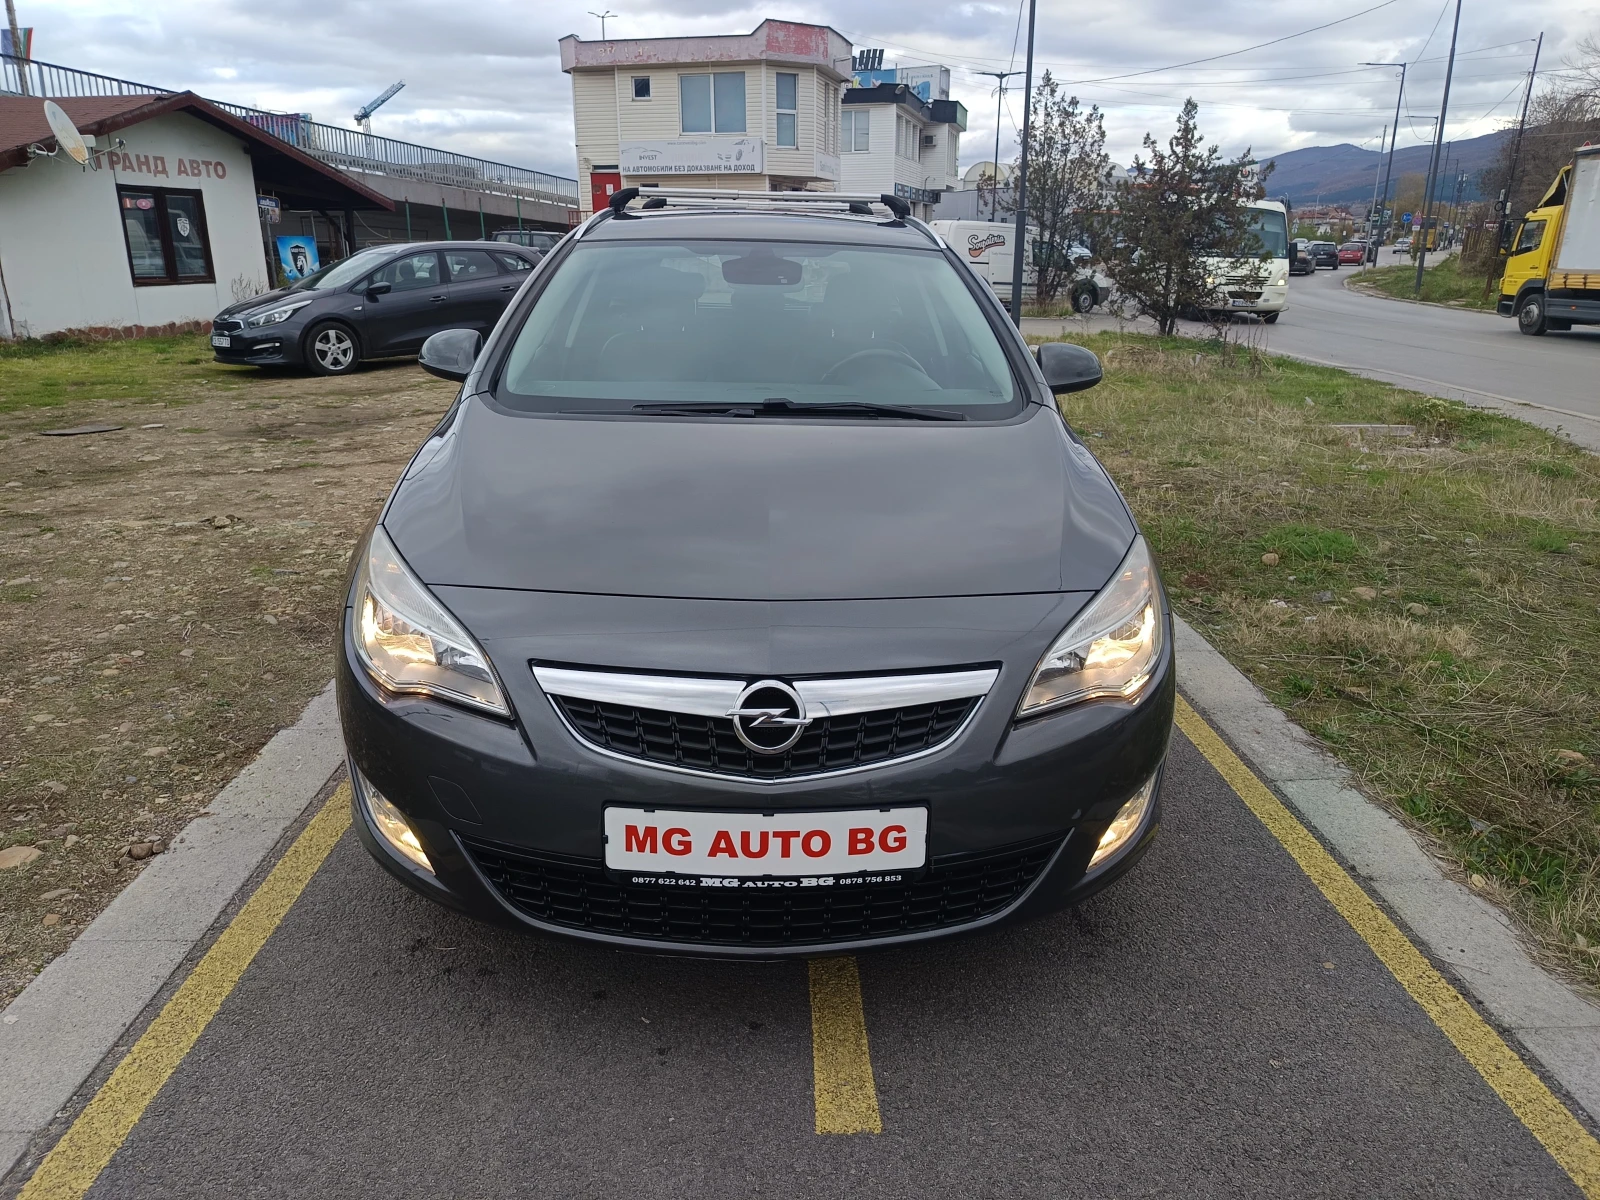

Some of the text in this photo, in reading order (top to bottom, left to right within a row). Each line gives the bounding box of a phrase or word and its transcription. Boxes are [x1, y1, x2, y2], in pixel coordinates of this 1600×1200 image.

[94, 150, 227, 180] ГРАНД АВТО
[632, 165, 673, 173] АВТОМОБИЛИ
[687, 164, 723, 173] ДОКАЗВАНЕ
[724, 164, 732, 172] НА
[733, 164, 755, 173] ДОХОД
[968, 233, 1006, 252] Soupateria
[624, 824, 908, 859] MG AUTO BG
[632, 876, 657, 884] 0877
[658, 877, 676, 885] 622
[678, 878, 696, 887] 642
[700, 877, 740, 888] MG
[741, 880, 798, 889] AUTO
[799, 876, 836, 888] BG
[839, 876, 863, 885] 0878
